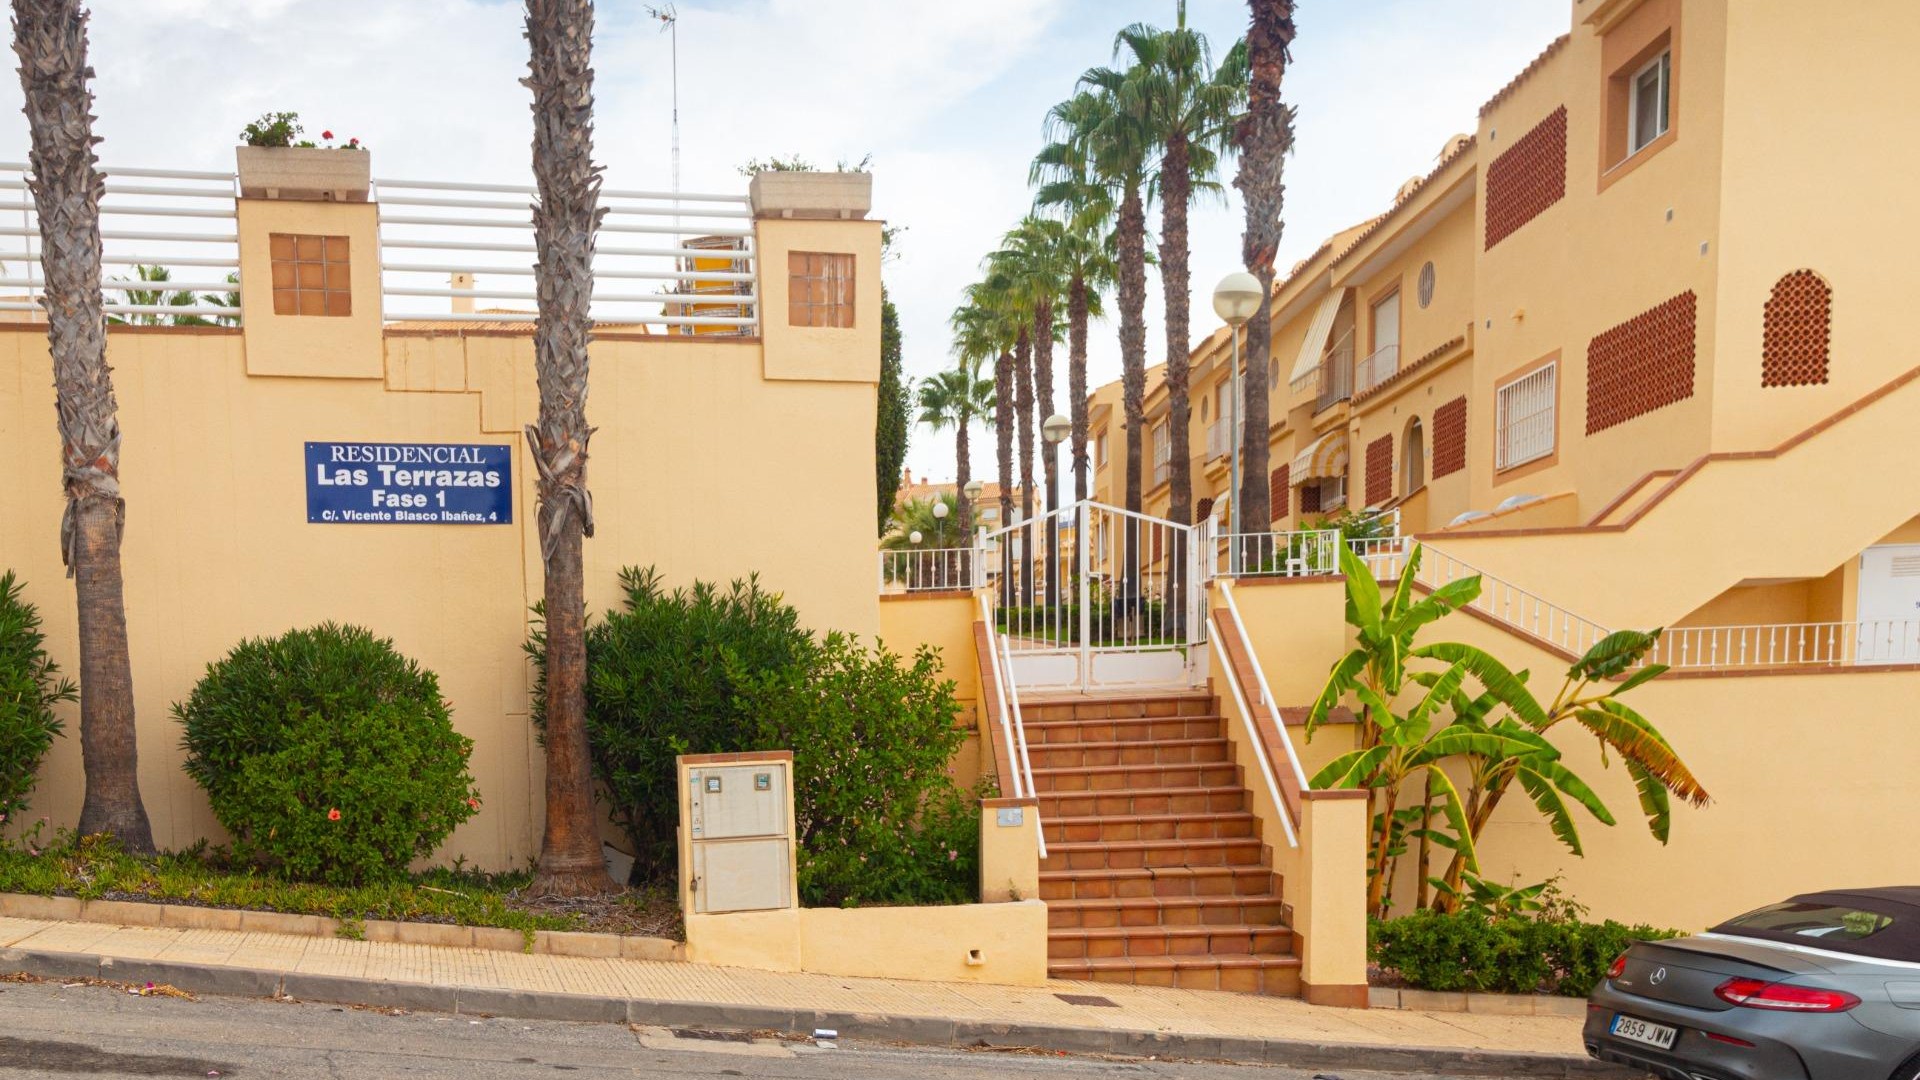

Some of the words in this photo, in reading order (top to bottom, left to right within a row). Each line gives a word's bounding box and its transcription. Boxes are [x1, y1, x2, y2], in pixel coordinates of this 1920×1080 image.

[330, 445, 486, 464] RESIDENCIAL
[317, 463, 369, 486] Las
[377, 464, 501, 488] Terrazas
[372, 489, 428, 507] Fase
[435, 490, 446, 507] 1
[322, 510, 339, 521] C/.
[342, 510, 392, 521] Vicente
[395, 510, 438, 521] Blasco
[441, 510, 486, 523] Ibañez,
[489, 511, 497, 522] 4
[1616, 1018, 1646, 1038] 2859
[1647, 1026, 1673, 1045] JWM
